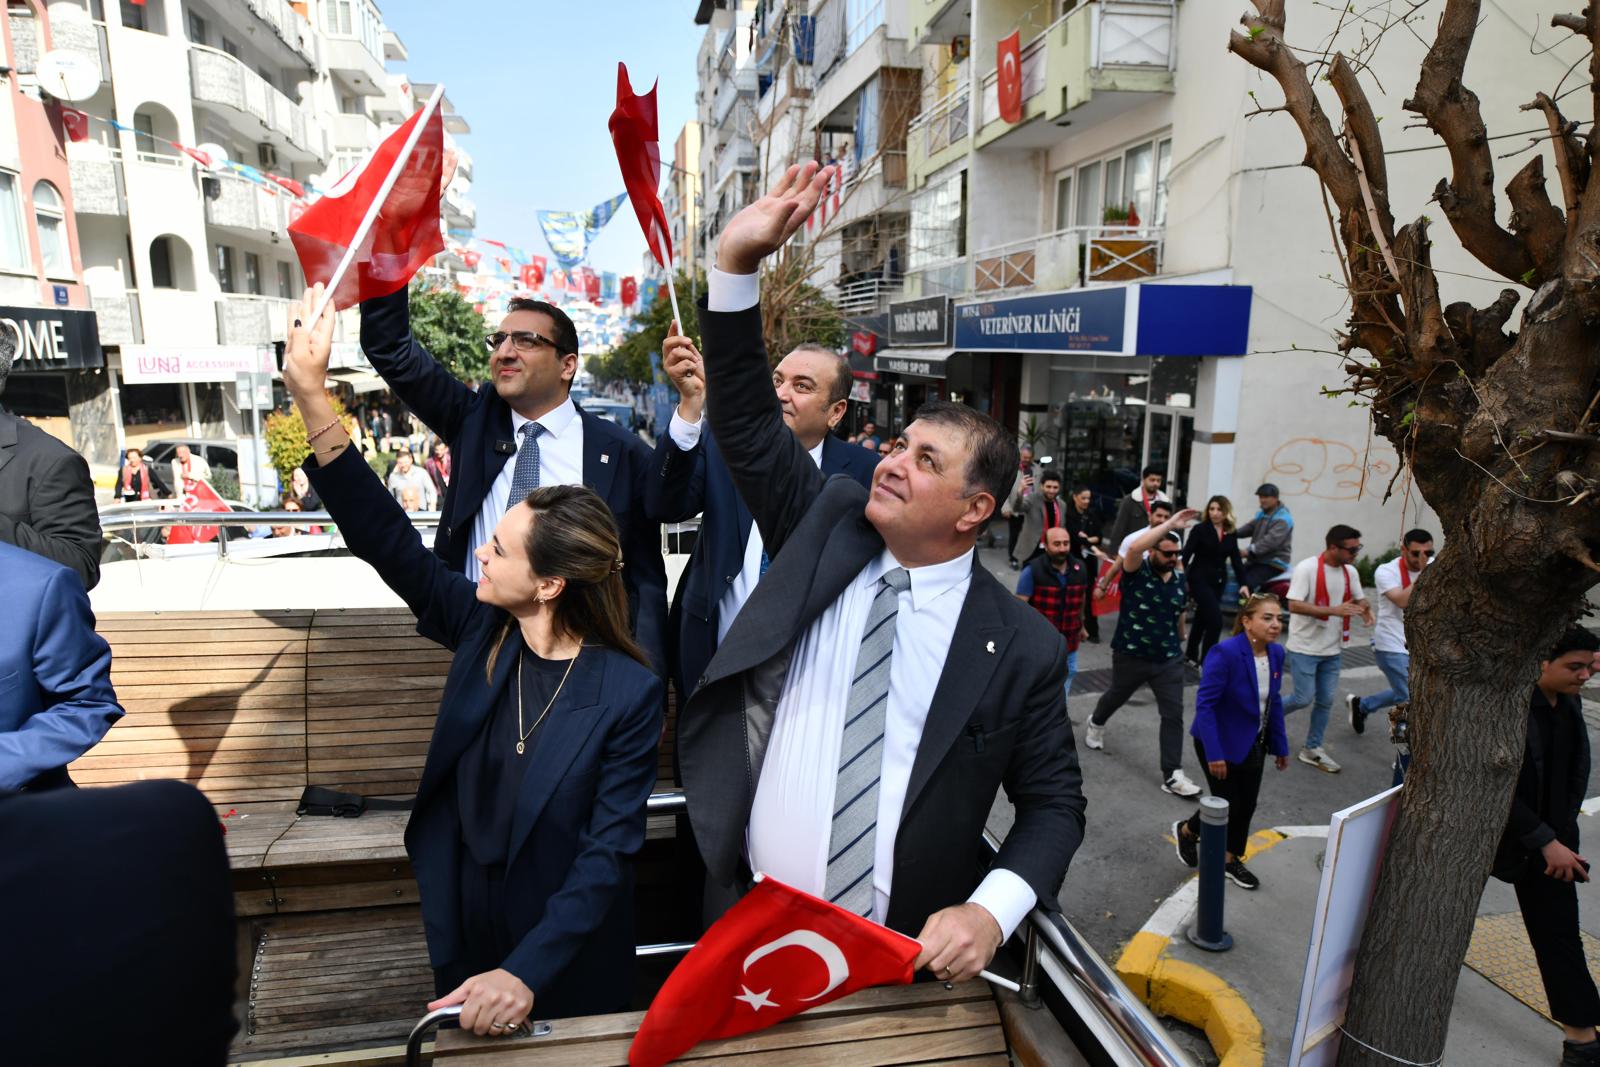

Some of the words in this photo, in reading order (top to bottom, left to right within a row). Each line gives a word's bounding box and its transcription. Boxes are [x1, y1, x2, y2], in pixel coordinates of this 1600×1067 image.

[894, 308, 916, 333] YASİN
[917, 309, 939, 332] SPOR
[980, 312, 1032, 335] VETERİNER
[1033, 307, 1080, 333] KLİNİĞİ
[186, 360, 250, 369] ACCESSORIES
[910, 361, 930, 374] SPOR
